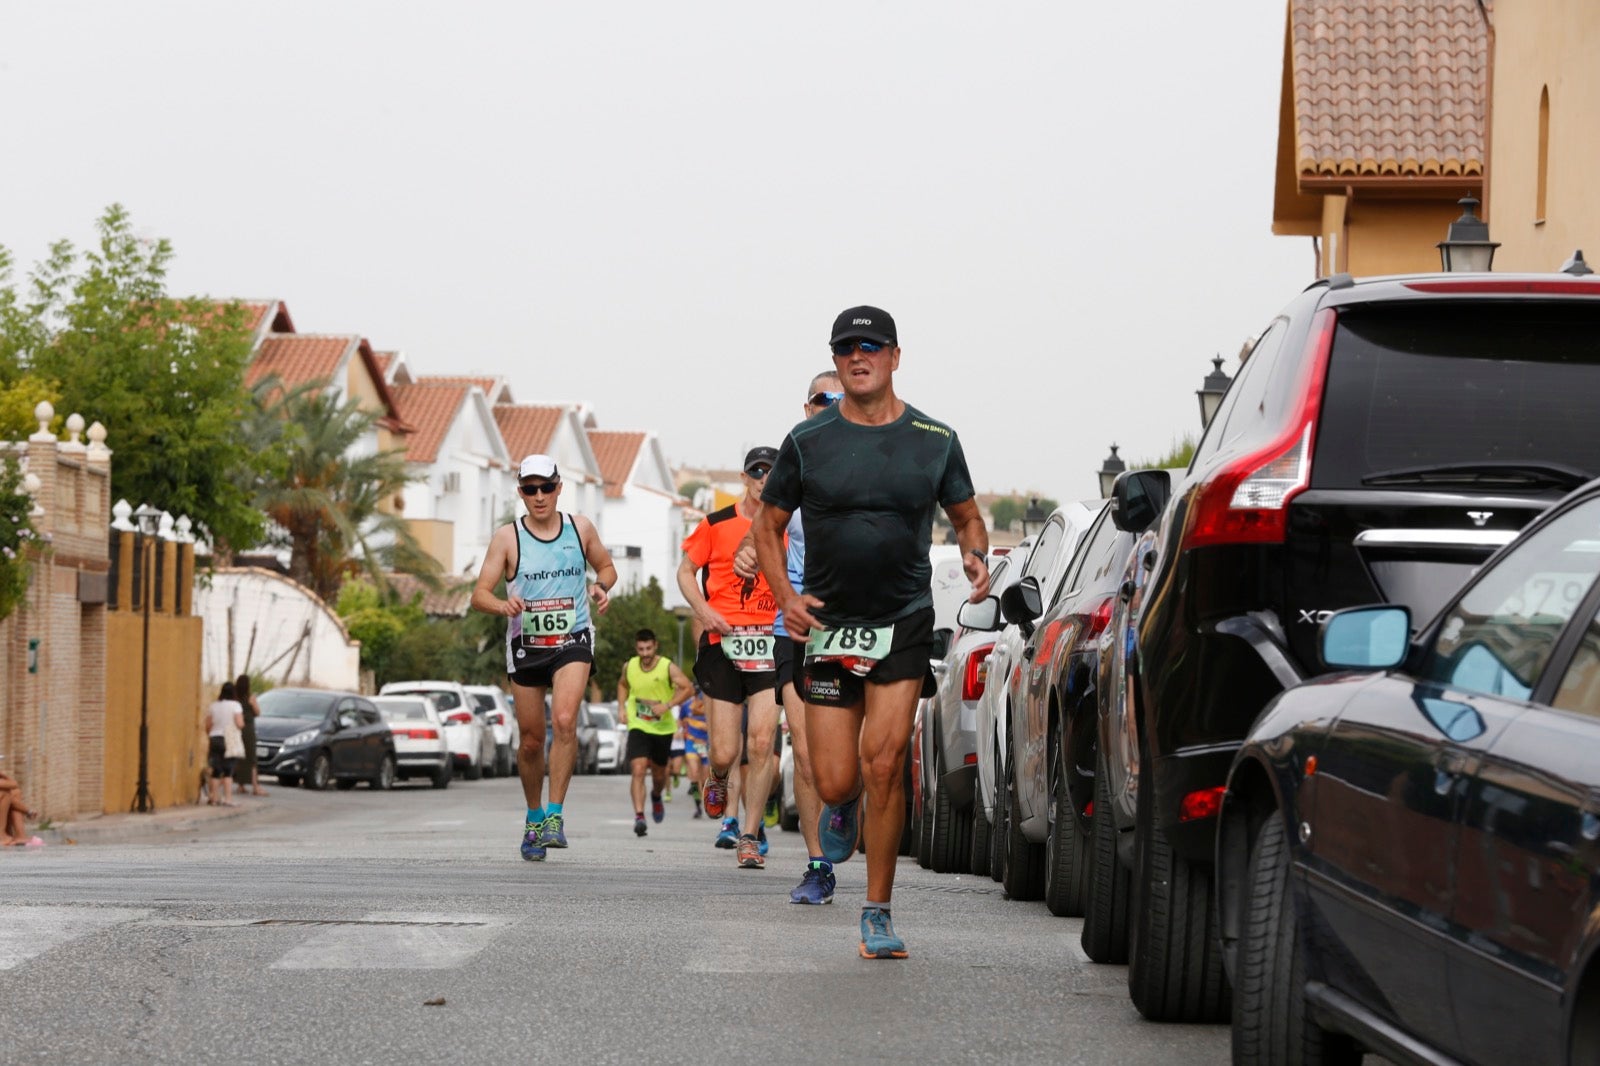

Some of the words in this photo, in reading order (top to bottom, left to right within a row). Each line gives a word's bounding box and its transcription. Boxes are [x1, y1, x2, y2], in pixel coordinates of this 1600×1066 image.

[911, 420, 930, 431] JOHN
[930, 425, 950, 438] SMITH
[531, 613, 568, 631] 165
[732, 639, 768, 656] 309
[823, 626, 877, 651] 789
